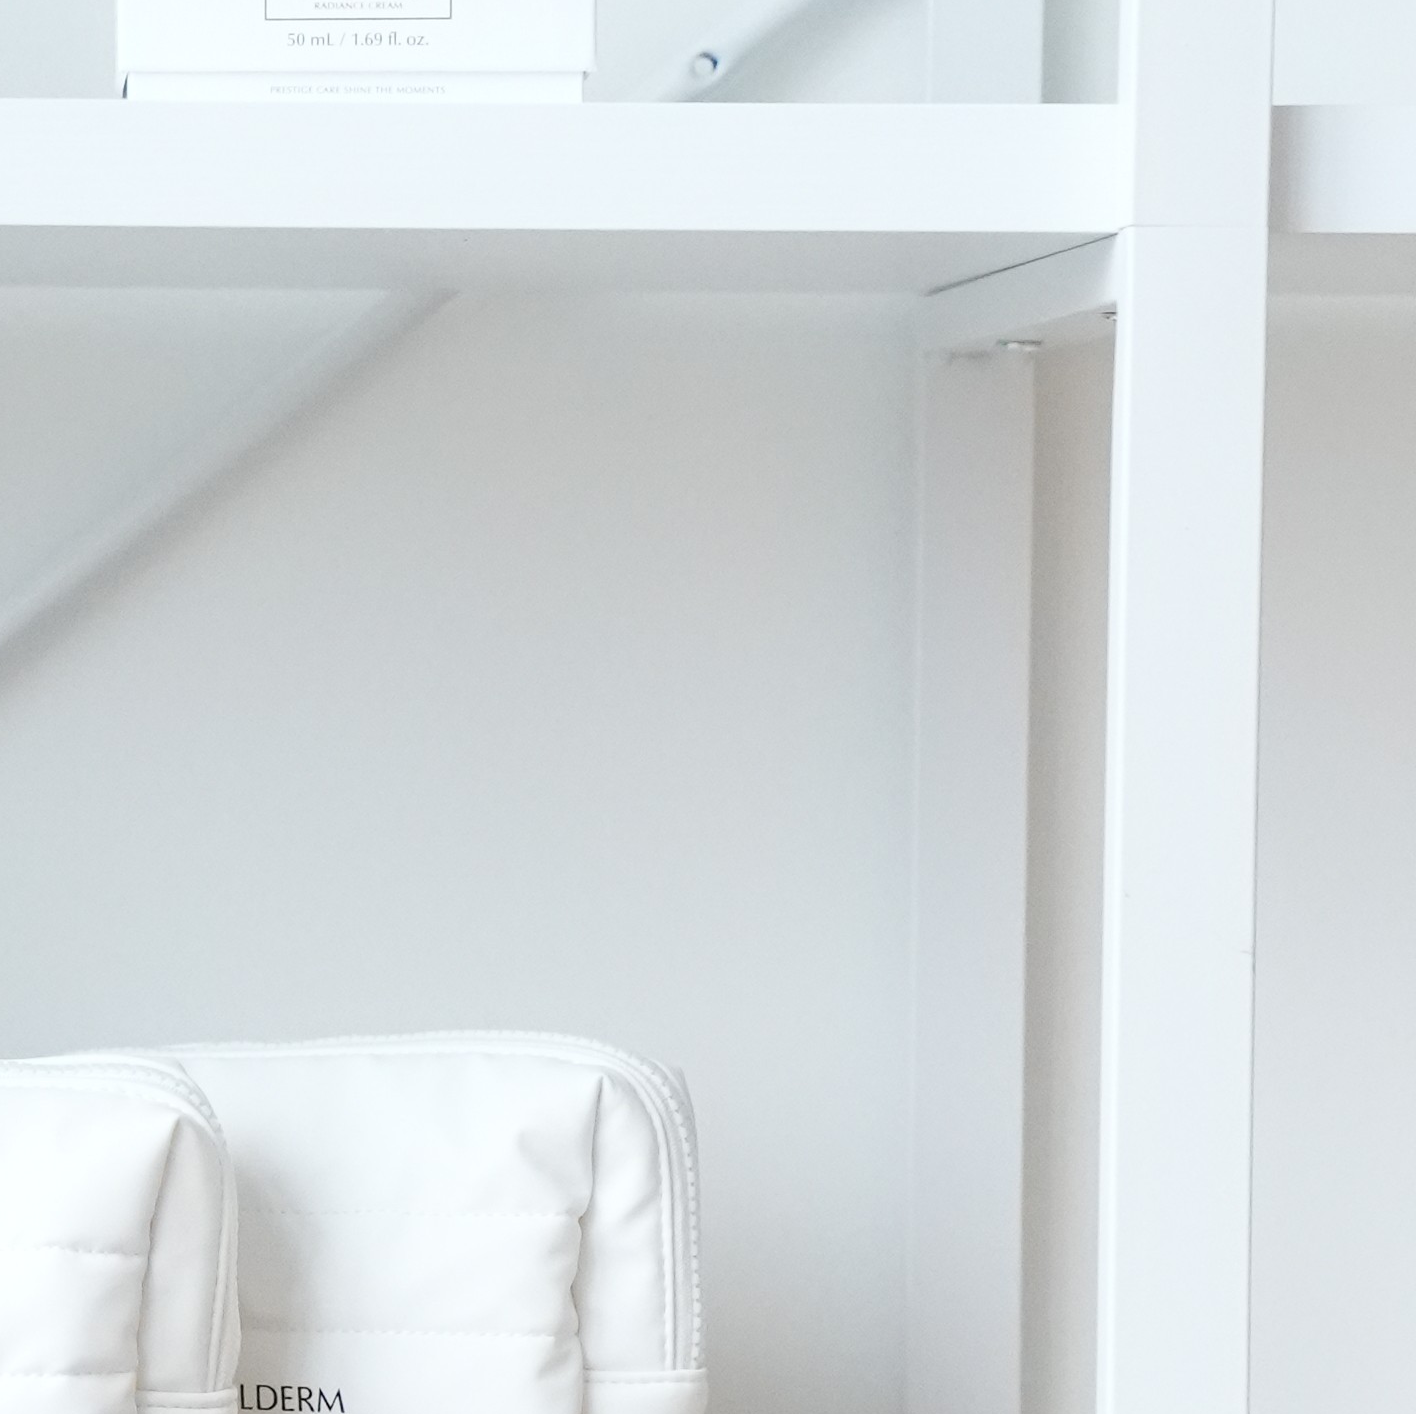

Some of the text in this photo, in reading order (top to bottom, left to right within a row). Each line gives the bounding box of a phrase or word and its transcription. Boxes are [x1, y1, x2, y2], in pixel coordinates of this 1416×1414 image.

[314, 2, 365, 10] RADIANCE
[287, 31, 429, 47] 50 mL / 1.69 fl. oz.
[270, 86, 445, 94] PRESTIGE CARE SHINE THE MOMENTS
